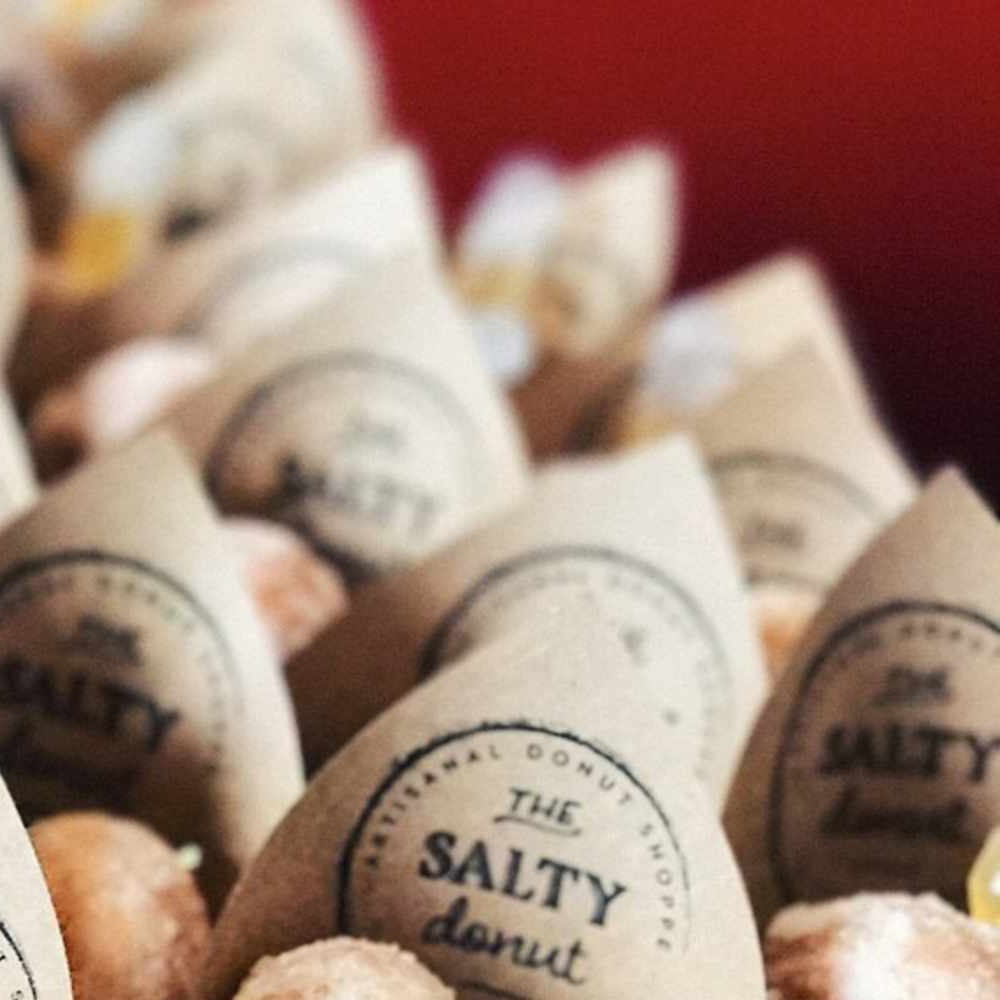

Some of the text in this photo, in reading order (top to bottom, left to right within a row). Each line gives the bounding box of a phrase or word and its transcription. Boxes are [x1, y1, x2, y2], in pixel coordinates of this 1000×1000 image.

[364, 743, 676, 953] ARTISANAL DONUT SHOPPE
[508, 786, 583, 827] THE
[418, 830, 628, 928] SALTY
[420, 896, 587, 987] donut
